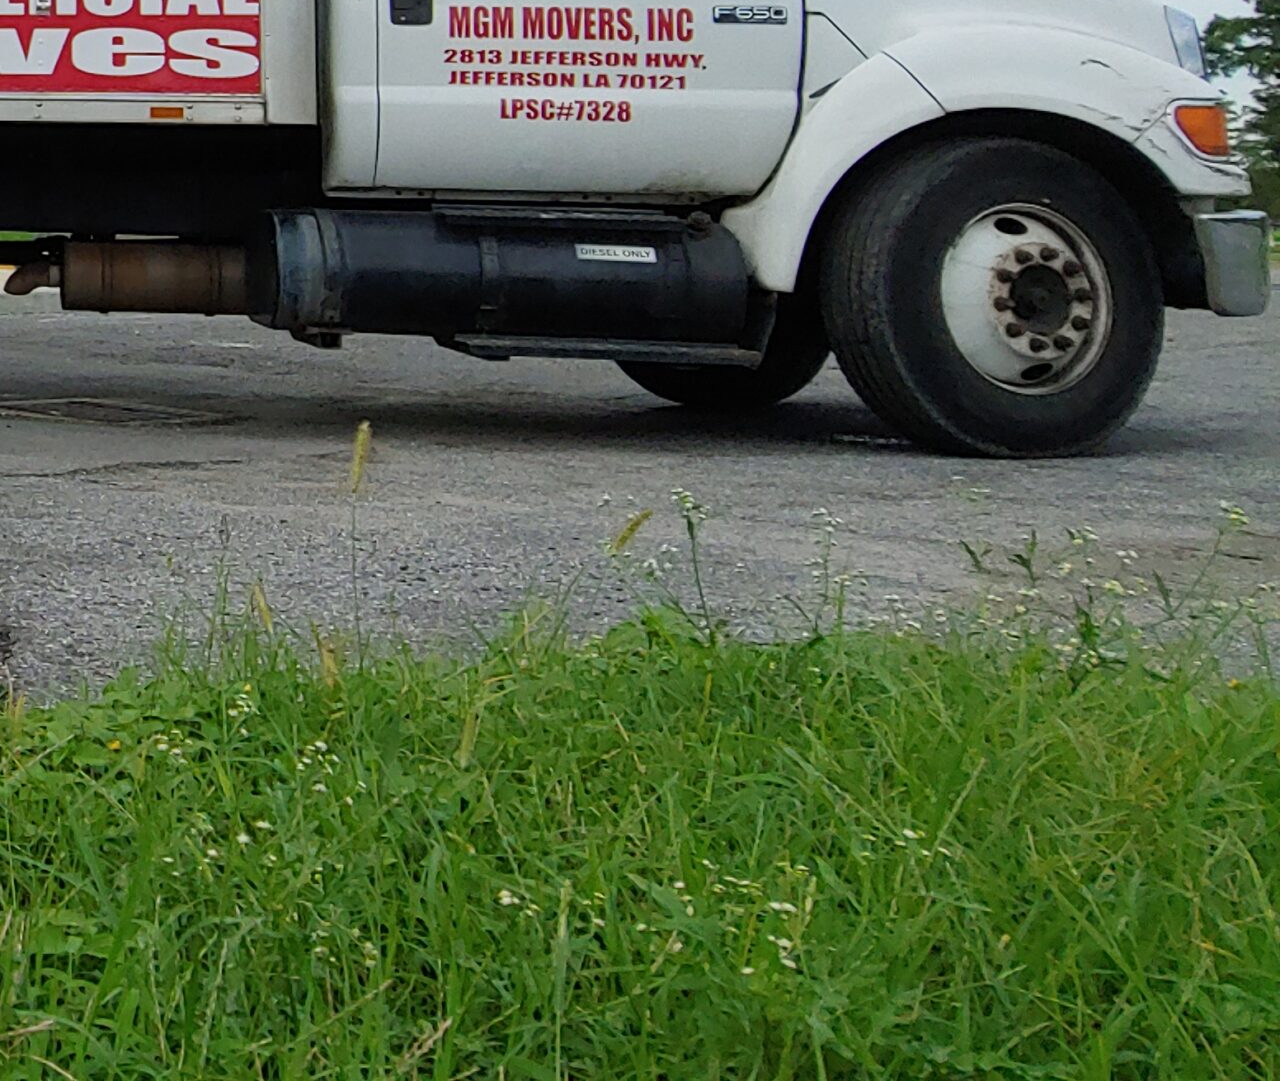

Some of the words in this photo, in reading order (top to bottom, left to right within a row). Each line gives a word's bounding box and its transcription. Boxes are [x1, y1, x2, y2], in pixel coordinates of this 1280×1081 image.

[449, 6, 514, 39] MGM
[523, 7, 639, 45] MOVERS,
[647, 8, 694, 42] INC
[444, 49, 502, 65] 2813
[509, 50, 637, 68] JEFFERSON
[645, 54, 707, 70] HWY.
[448, 71, 575, 88] JEFFERSON
[583, 74, 611, 89] LA
[616, 74, 687, 90] 70121
[500, 99, 632, 123] LPSC#7328
[580, 247, 620, 257] DIESEL
[622, 250, 650, 258] ONLY
